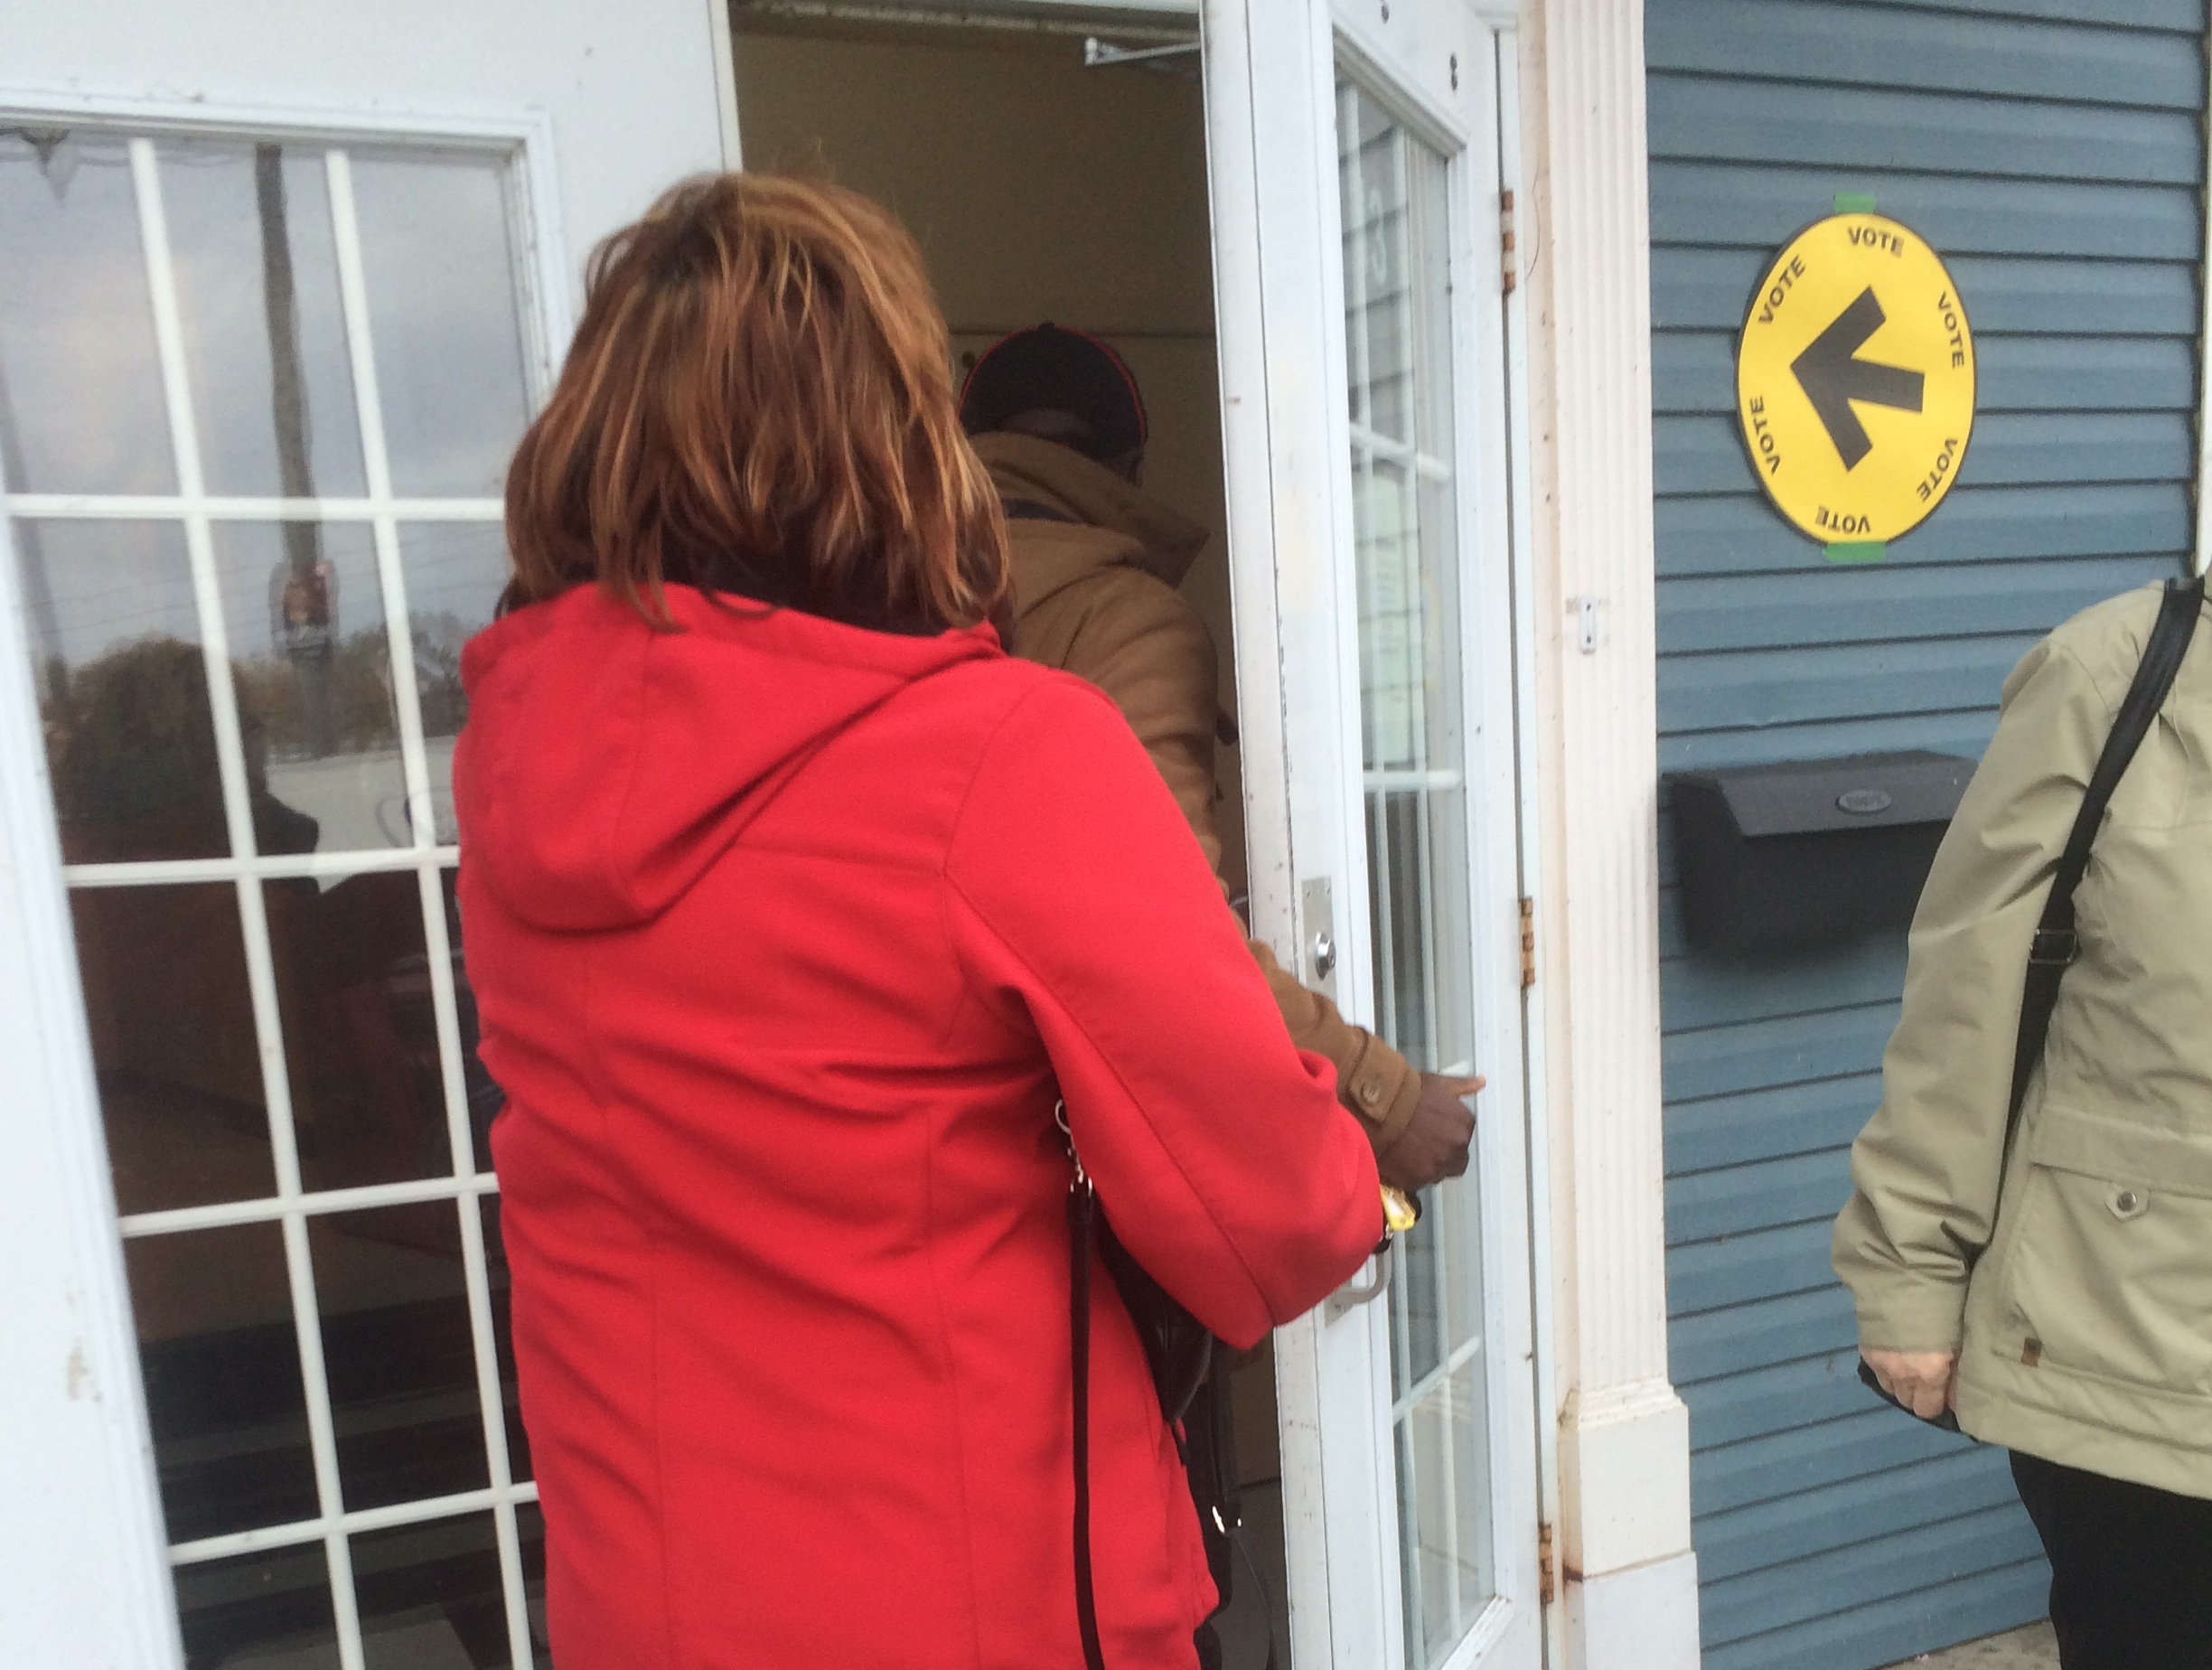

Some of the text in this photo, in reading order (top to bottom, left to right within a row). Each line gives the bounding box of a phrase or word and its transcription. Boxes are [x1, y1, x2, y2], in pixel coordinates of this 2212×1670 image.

[1848, 227, 1904, 258] VOTE
[1758, 255, 1806, 325] VOTE
[1937, 292, 1965, 369] VOTE
[1749, 395, 1781, 474] VOTE
[1917, 437, 1958, 502] VOTE
[1814, 506, 1871, 534] VOTE
